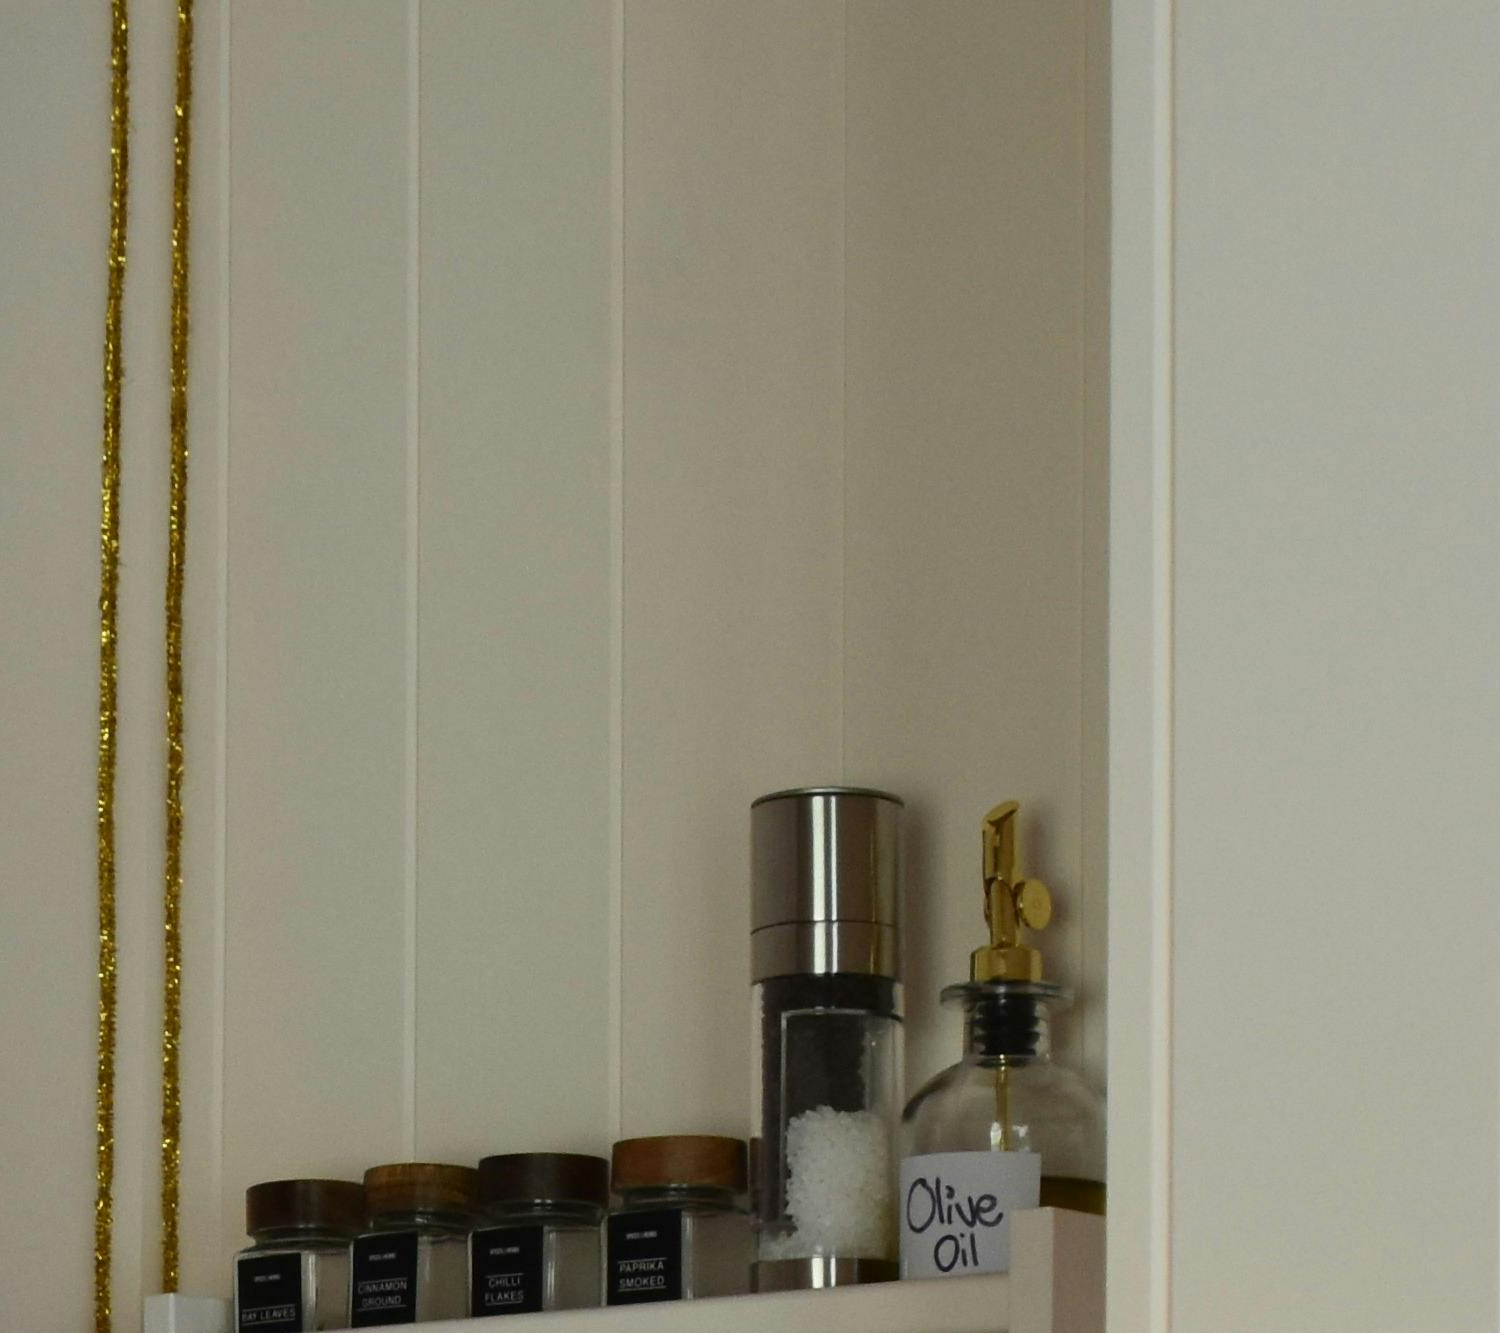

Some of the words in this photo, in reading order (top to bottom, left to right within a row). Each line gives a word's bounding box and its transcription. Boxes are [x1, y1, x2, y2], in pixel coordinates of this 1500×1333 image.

[907, 1176, 1004, 1234] Olive
[933, 1231, 979, 1272] Oil
[619, 1261, 665, 1273] PAPRIKA
[357, 1280, 408, 1295] CINNAMON
[488, 1276, 521, 1288] CHILLI
[618, 1275, 665, 1288] SMOKED
[361, 1295, 402, 1307] GROUND
[484, 1290, 524, 1301] FLAKES
[260, 1307, 296, 1321] LEAVES
